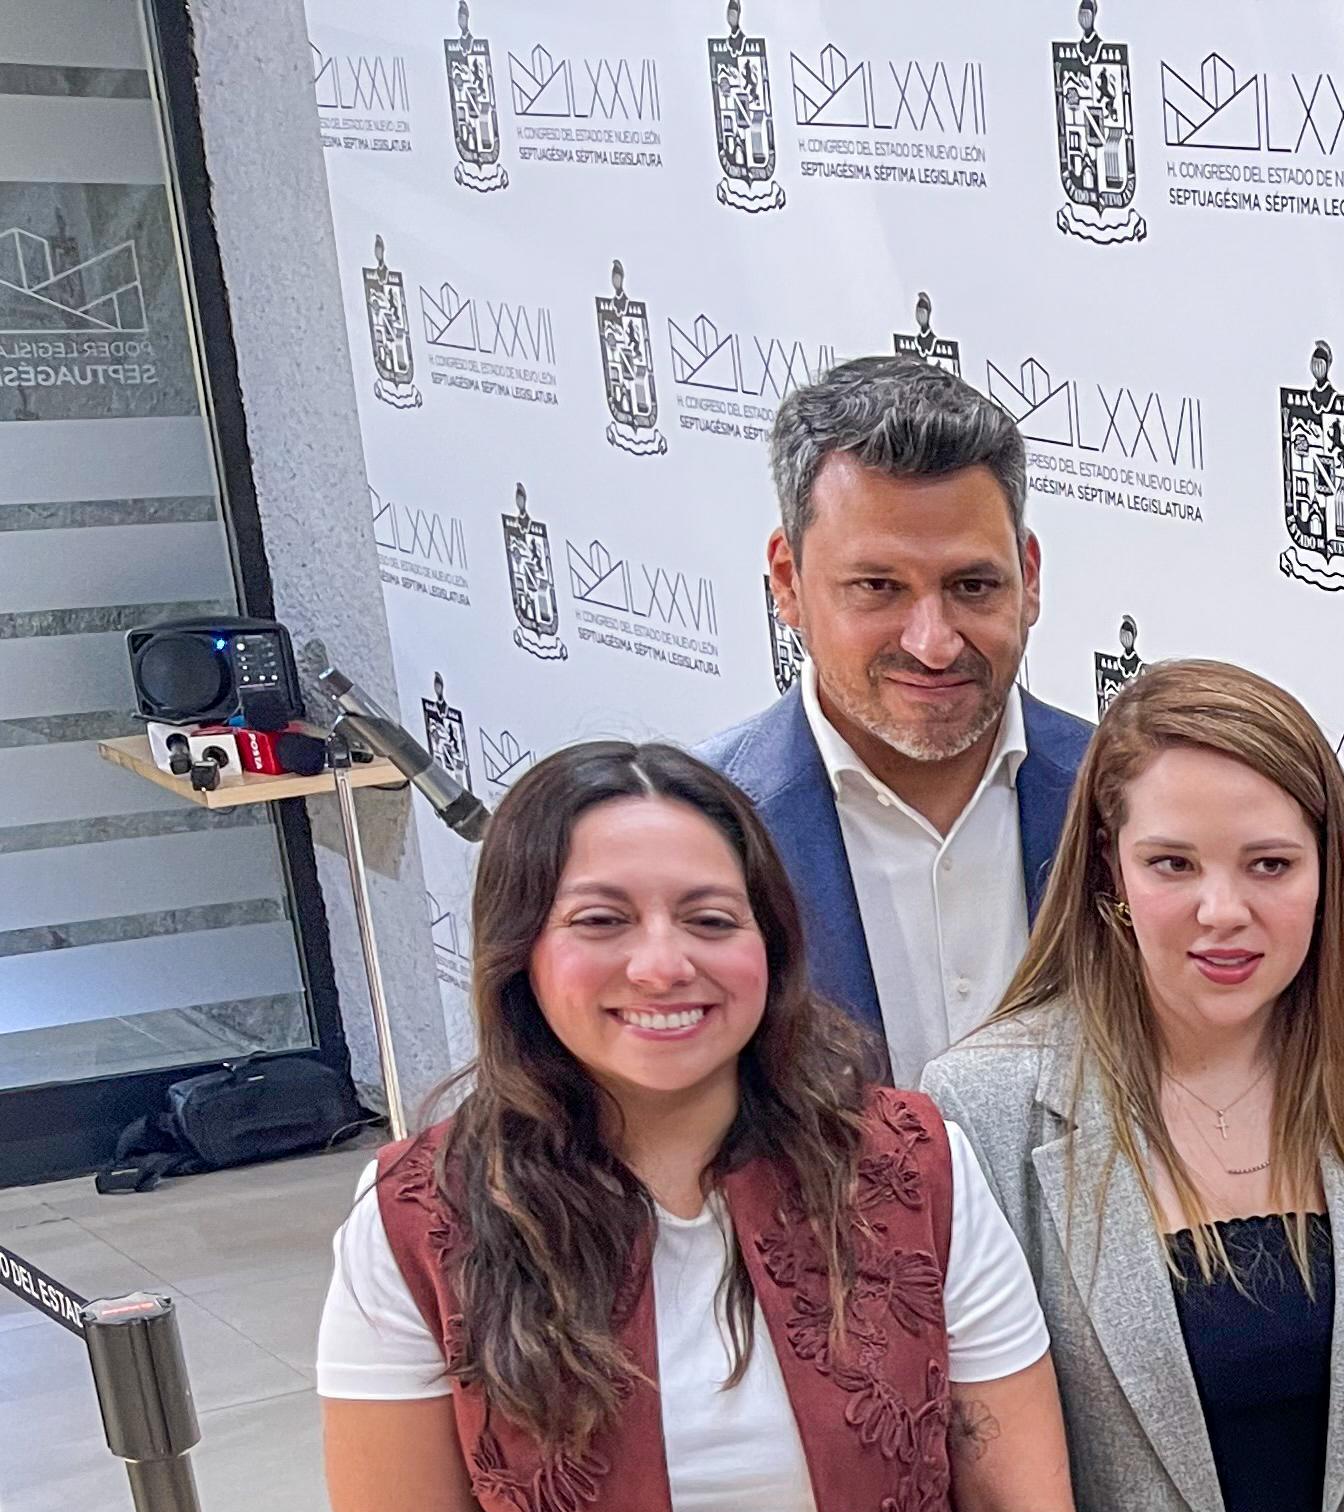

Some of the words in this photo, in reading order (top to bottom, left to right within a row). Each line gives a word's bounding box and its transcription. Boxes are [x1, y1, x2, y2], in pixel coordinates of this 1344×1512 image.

[334, 56, 409, 112] LXXVII
[568, 59, 660, 121] LXXVII
[868, 61, 986, 135] LXXVII
[807, 138, 855, 154] CONGRESO
[857, 141, 873, 156] DEL
[875, 142, 910, 157] ESTADO
[911, 144, 924, 158] DE
[925, 145, 958, 161] NUEVO
[918, 168, 987, 187] LEGISLATURA
[1179, 162, 1241, 182] CONGRESO
[1243, 166, 1266, 183] DEL
[1268, 167, 1313, 186] ESTADO
[1316, 170, 1333, 187] DE
[1169, 187, 1261, 211] SEPTUAGÉSIMA
[1265, 194, 1320, 215] SÉPTIMA
[473, 299, 556, 366] LXXVII
[1073, 380, 1203, 470] LXXVII
[1028, 476, 1075, 499] AGÉSIMA
[1077, 484, 1125, 508] SÉPTIMA
[1127, 494, 1203, 522] LEGISLATURA
[1059, 458, 1078, 475] DEL
[1079, 462, 1118, 481] ESTADO
[1120, 469, 1134, 484] DE
[1136, 472, 1172, 492] NUEVO
[1174, 478, 1203, 498] LEÓN
[393, 503, 468, 570] LXXVII
[626, 560, 718, 636] LXXVII
[9, 1259, 41, 1300] DEL
[38, 1278, 84, 1328] ESTAD
